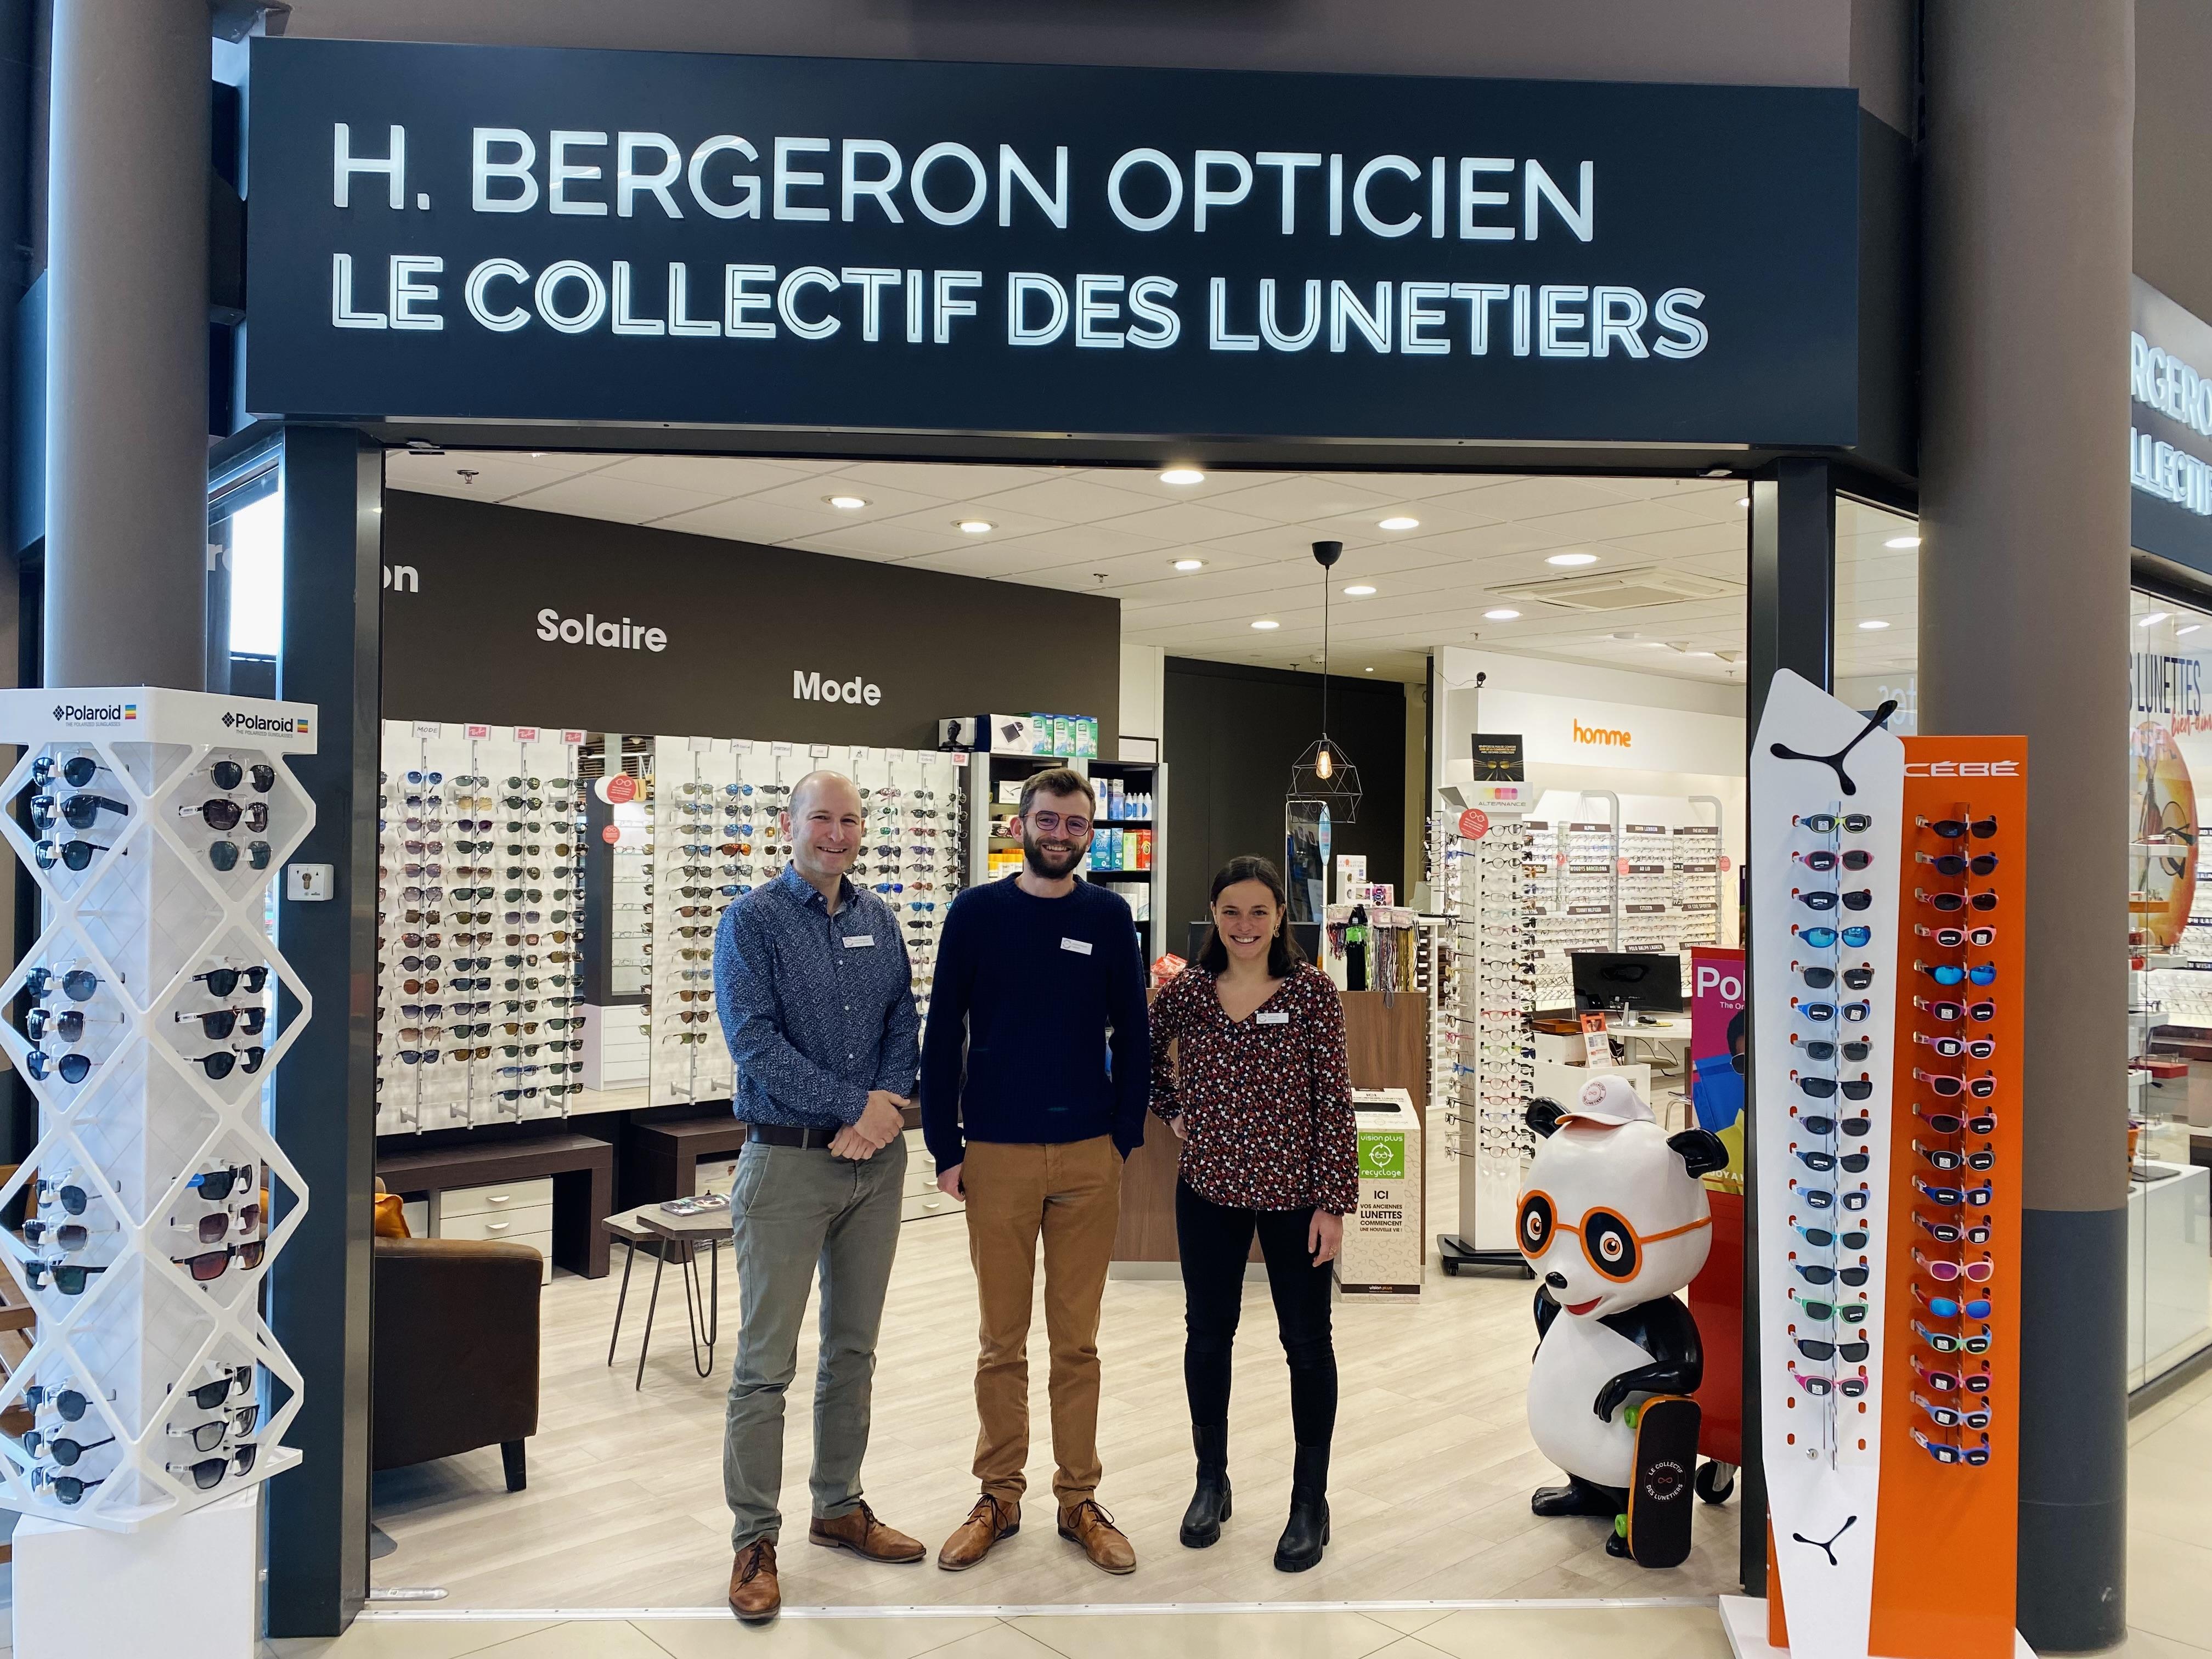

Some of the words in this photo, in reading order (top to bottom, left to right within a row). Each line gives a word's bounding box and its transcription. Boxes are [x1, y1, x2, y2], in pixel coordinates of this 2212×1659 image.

[332, 122, 430, 211] H.
[472, 127, 1068, 229] BERGERON
[1107, 148, 1594, 242] OPTICIEN
[332, 253, 444, 330] LE
[465, 257, 983, 344] COLLECTIF
[1007, 272, 1181, 349] DES
[1209, 276, 1709, 359] LUNETIERS
[536, 608, 668, 652] Solaire
[793, 670, 882, 706] Mode
[2137, 652, 2201, 716] LUNETTES
[65, 704, 121, 720] Polaroid
[236, 713, 294, 732] Polaroid
[1573, 719, 1632, 748] homme
[1904, 760, 2020, 777] CÉBÉ
[1361, 1168, 1402, 1178] recyclage
[1374, 1190, 1389, 1199] ICI
[1361, 1210, 1402, 1219] LUNETTES
[1648, 1468, 1656, 1476] LE
[1655, 1462, 1683, 1473] COLLECTIF
[1646, 1485, 1655, 1496] DES
[1654, 1483, 1683, 1500] LUNETIERS
